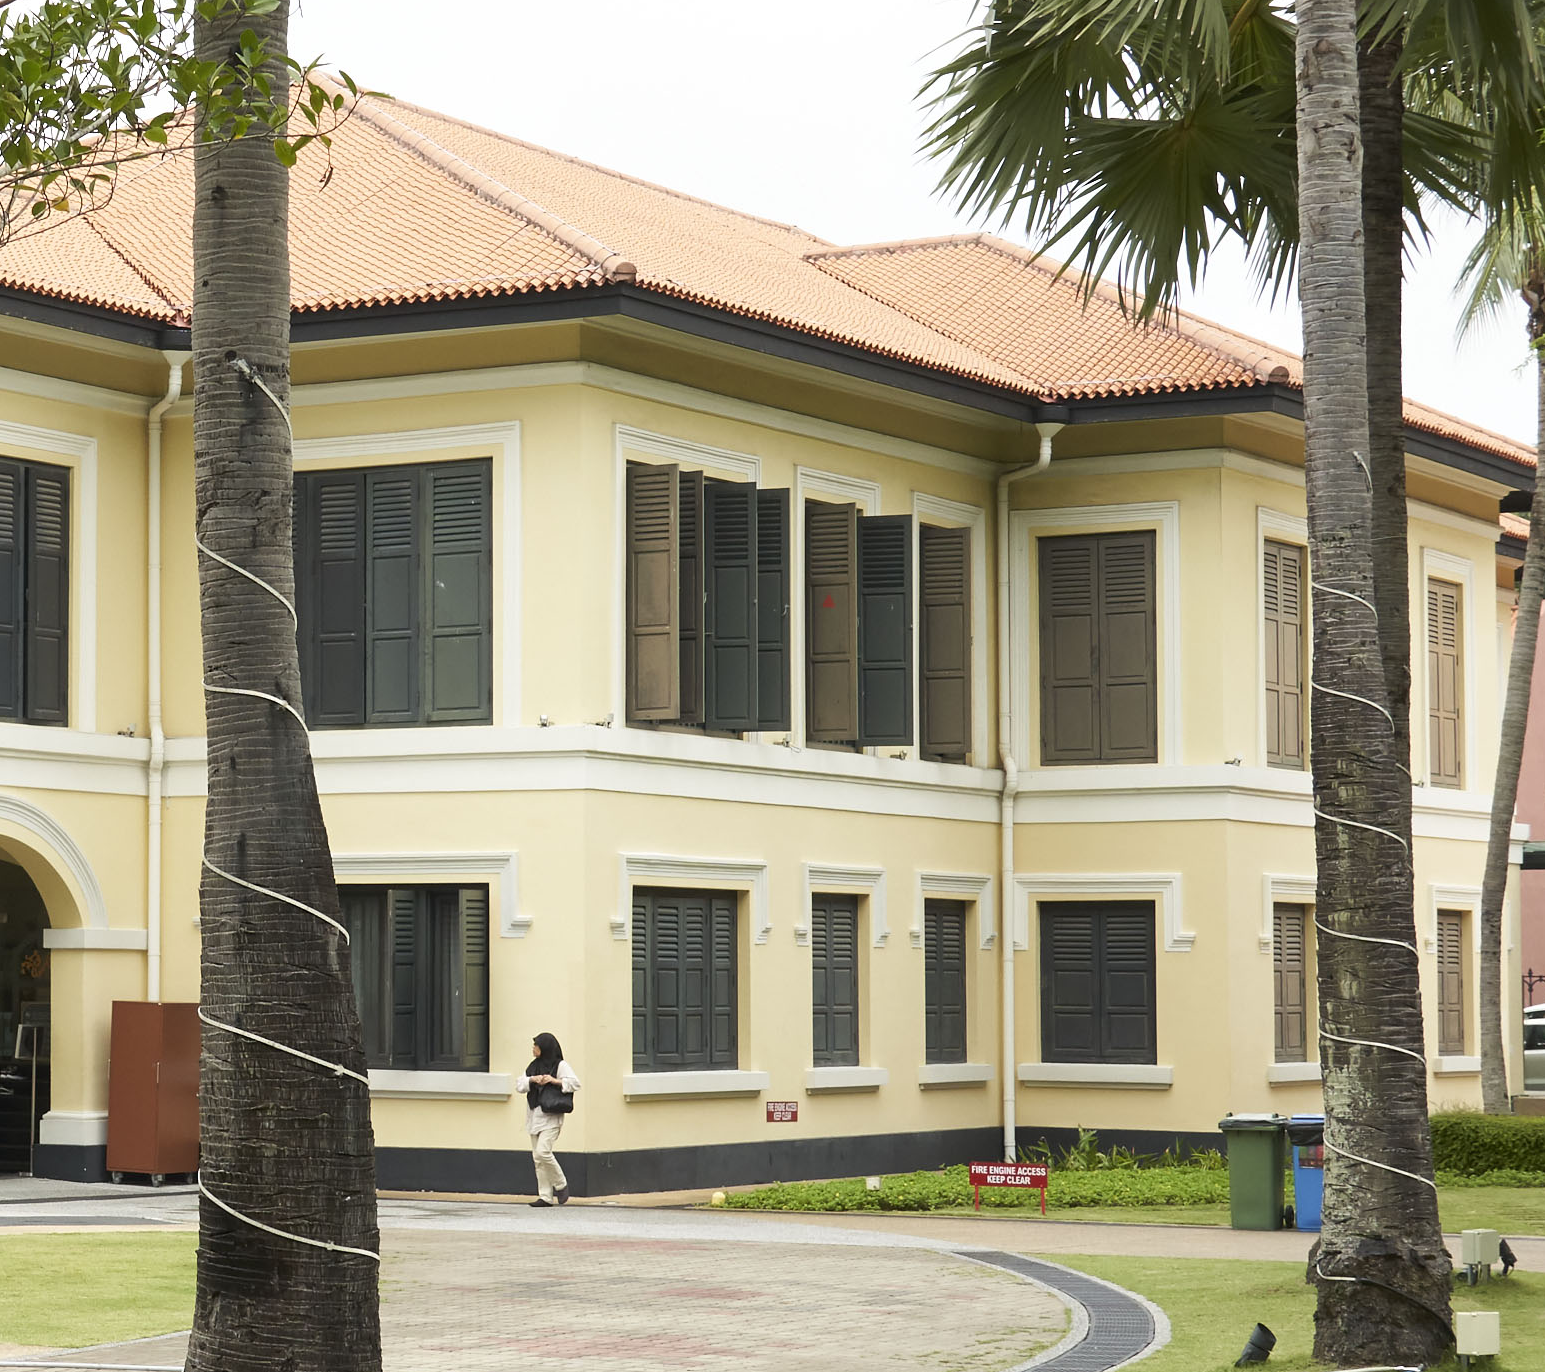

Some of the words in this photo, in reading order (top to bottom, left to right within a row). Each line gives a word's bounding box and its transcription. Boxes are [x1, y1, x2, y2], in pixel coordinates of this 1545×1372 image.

[971, 1165, 988, 1174] FIRE
[989, 1166, 1016, 1175] ENGINE
[1017, 1167, 1046, 1176] ACCESS
[987, 1175, 1005, 1184] KEEP
[1007, 1176, 1031, 1184] CLEAR
